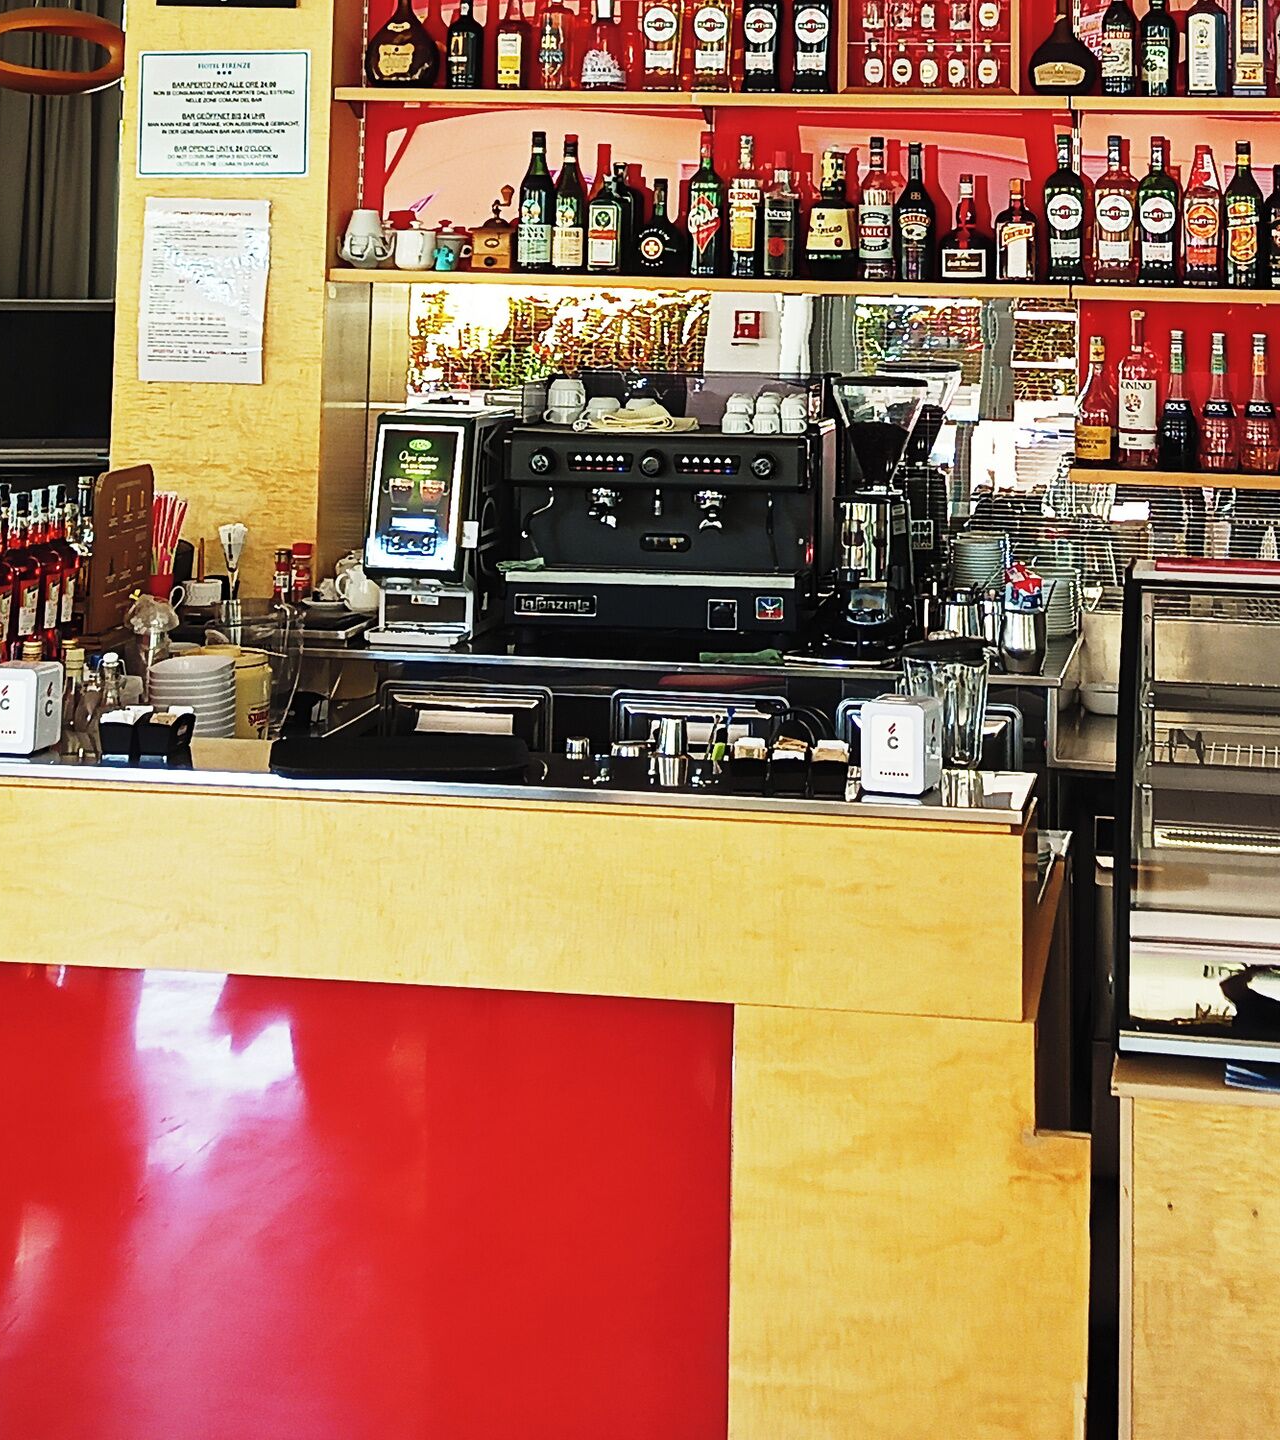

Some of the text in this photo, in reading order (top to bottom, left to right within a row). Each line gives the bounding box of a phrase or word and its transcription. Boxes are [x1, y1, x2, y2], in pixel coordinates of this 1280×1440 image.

[1120, 381, 1152, 391] ONINO
[1165, 402, 1187, 411] BOLS
[1206, 403, 1228, 412] BOLS
[1248, 404, 1271, 413] BOLS
[0, 698, 10, 710] C
[887, 736, 899, 750] C
